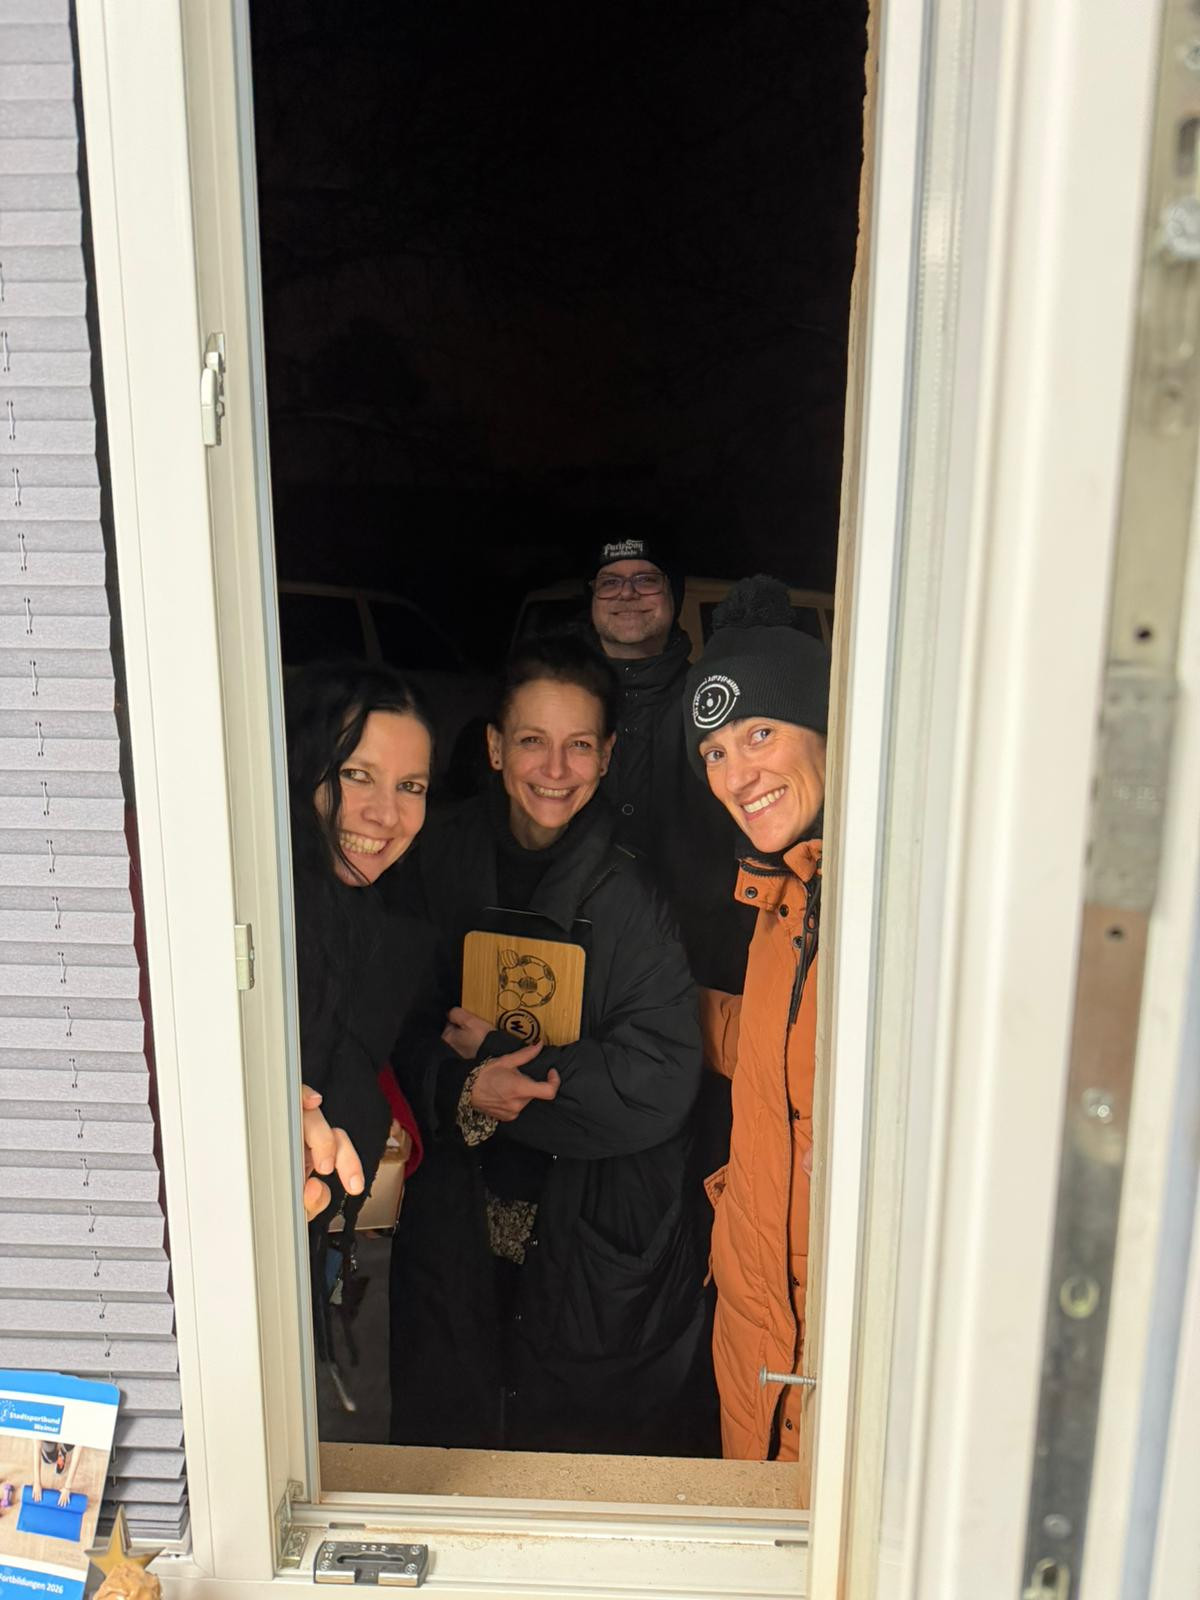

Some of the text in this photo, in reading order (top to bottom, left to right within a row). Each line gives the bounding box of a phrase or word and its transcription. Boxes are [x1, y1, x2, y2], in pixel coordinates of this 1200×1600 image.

[9, 1411, 60, 1424] Stadtsportbund
[34, 1423, 59, 1432] Weimar
[46, 1583, 64, 1594] 2026
